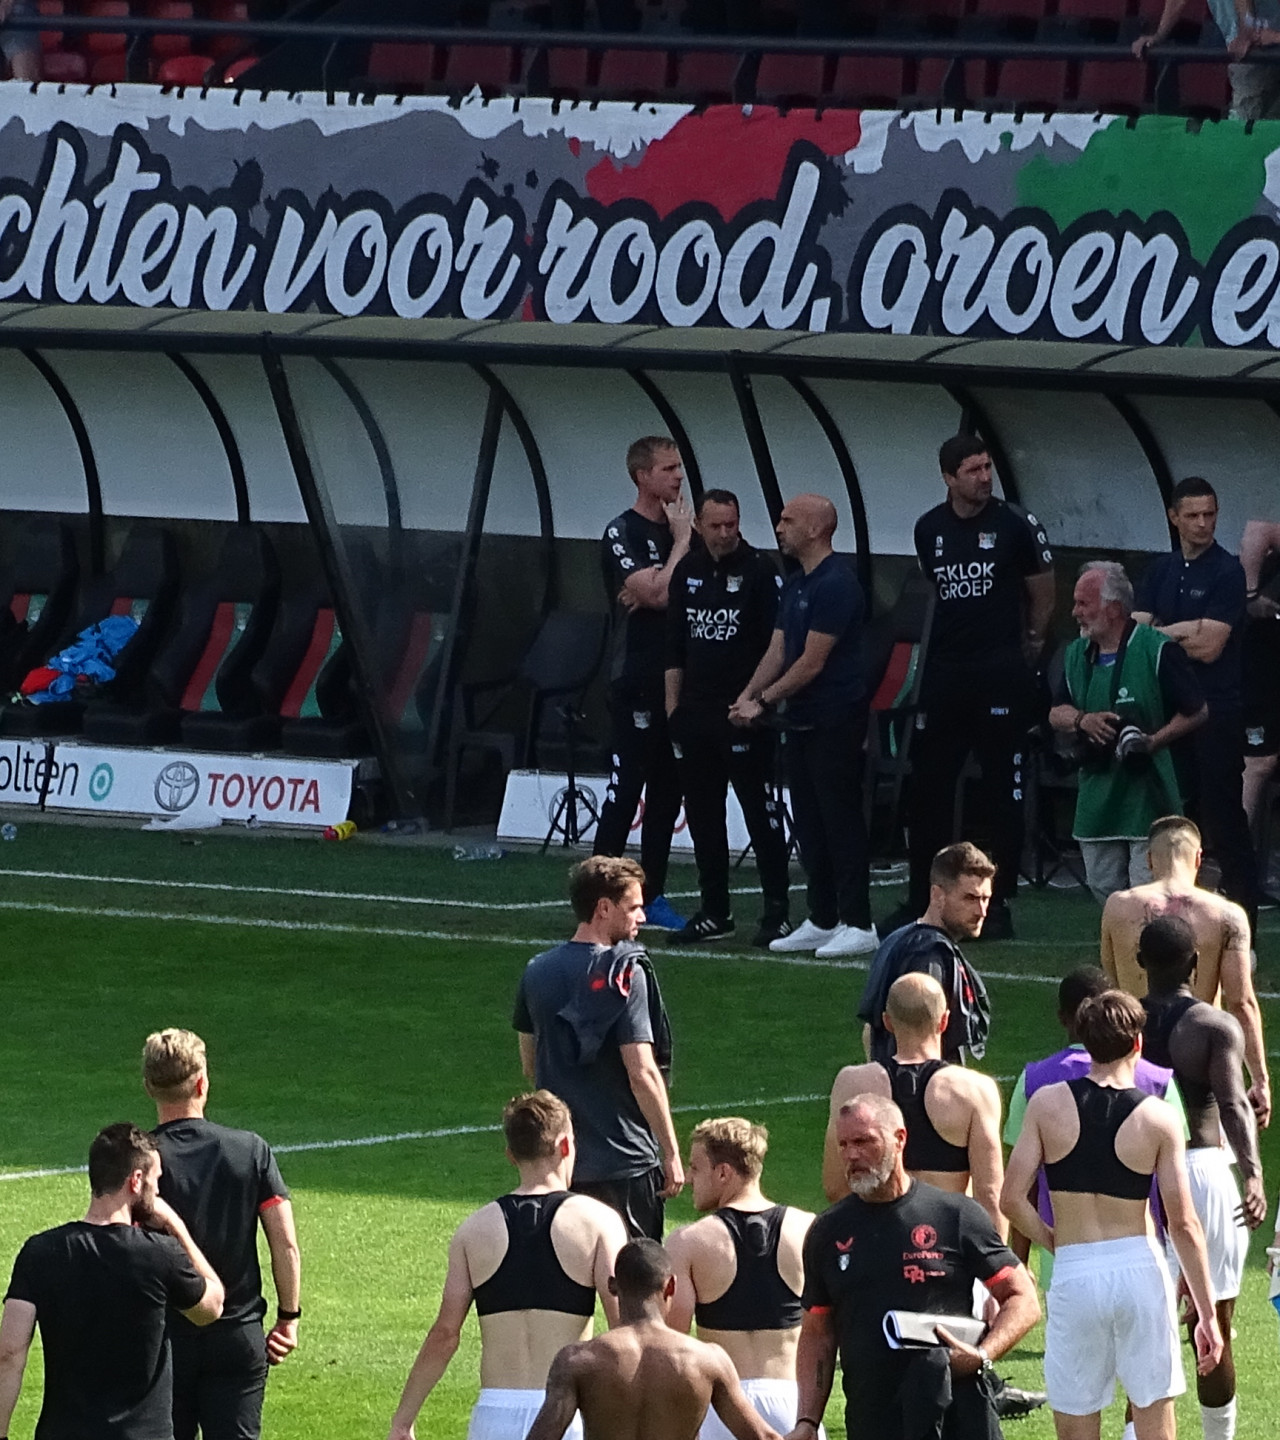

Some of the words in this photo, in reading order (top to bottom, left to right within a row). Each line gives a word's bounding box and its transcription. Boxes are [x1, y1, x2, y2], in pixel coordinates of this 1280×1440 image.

[264, 197, 521, 320] voor
[539, 161, 830, 332] rood,
[861, 206, 1199, 345] groen
[946, 562, 996, 582] KLOK
[939, 579, 994, 601] GROEP
[696, 608, 741, 625] KLOK
[690, 622, 738, 641] GROEP
[208, 773, 321, 813] TOYOTA
